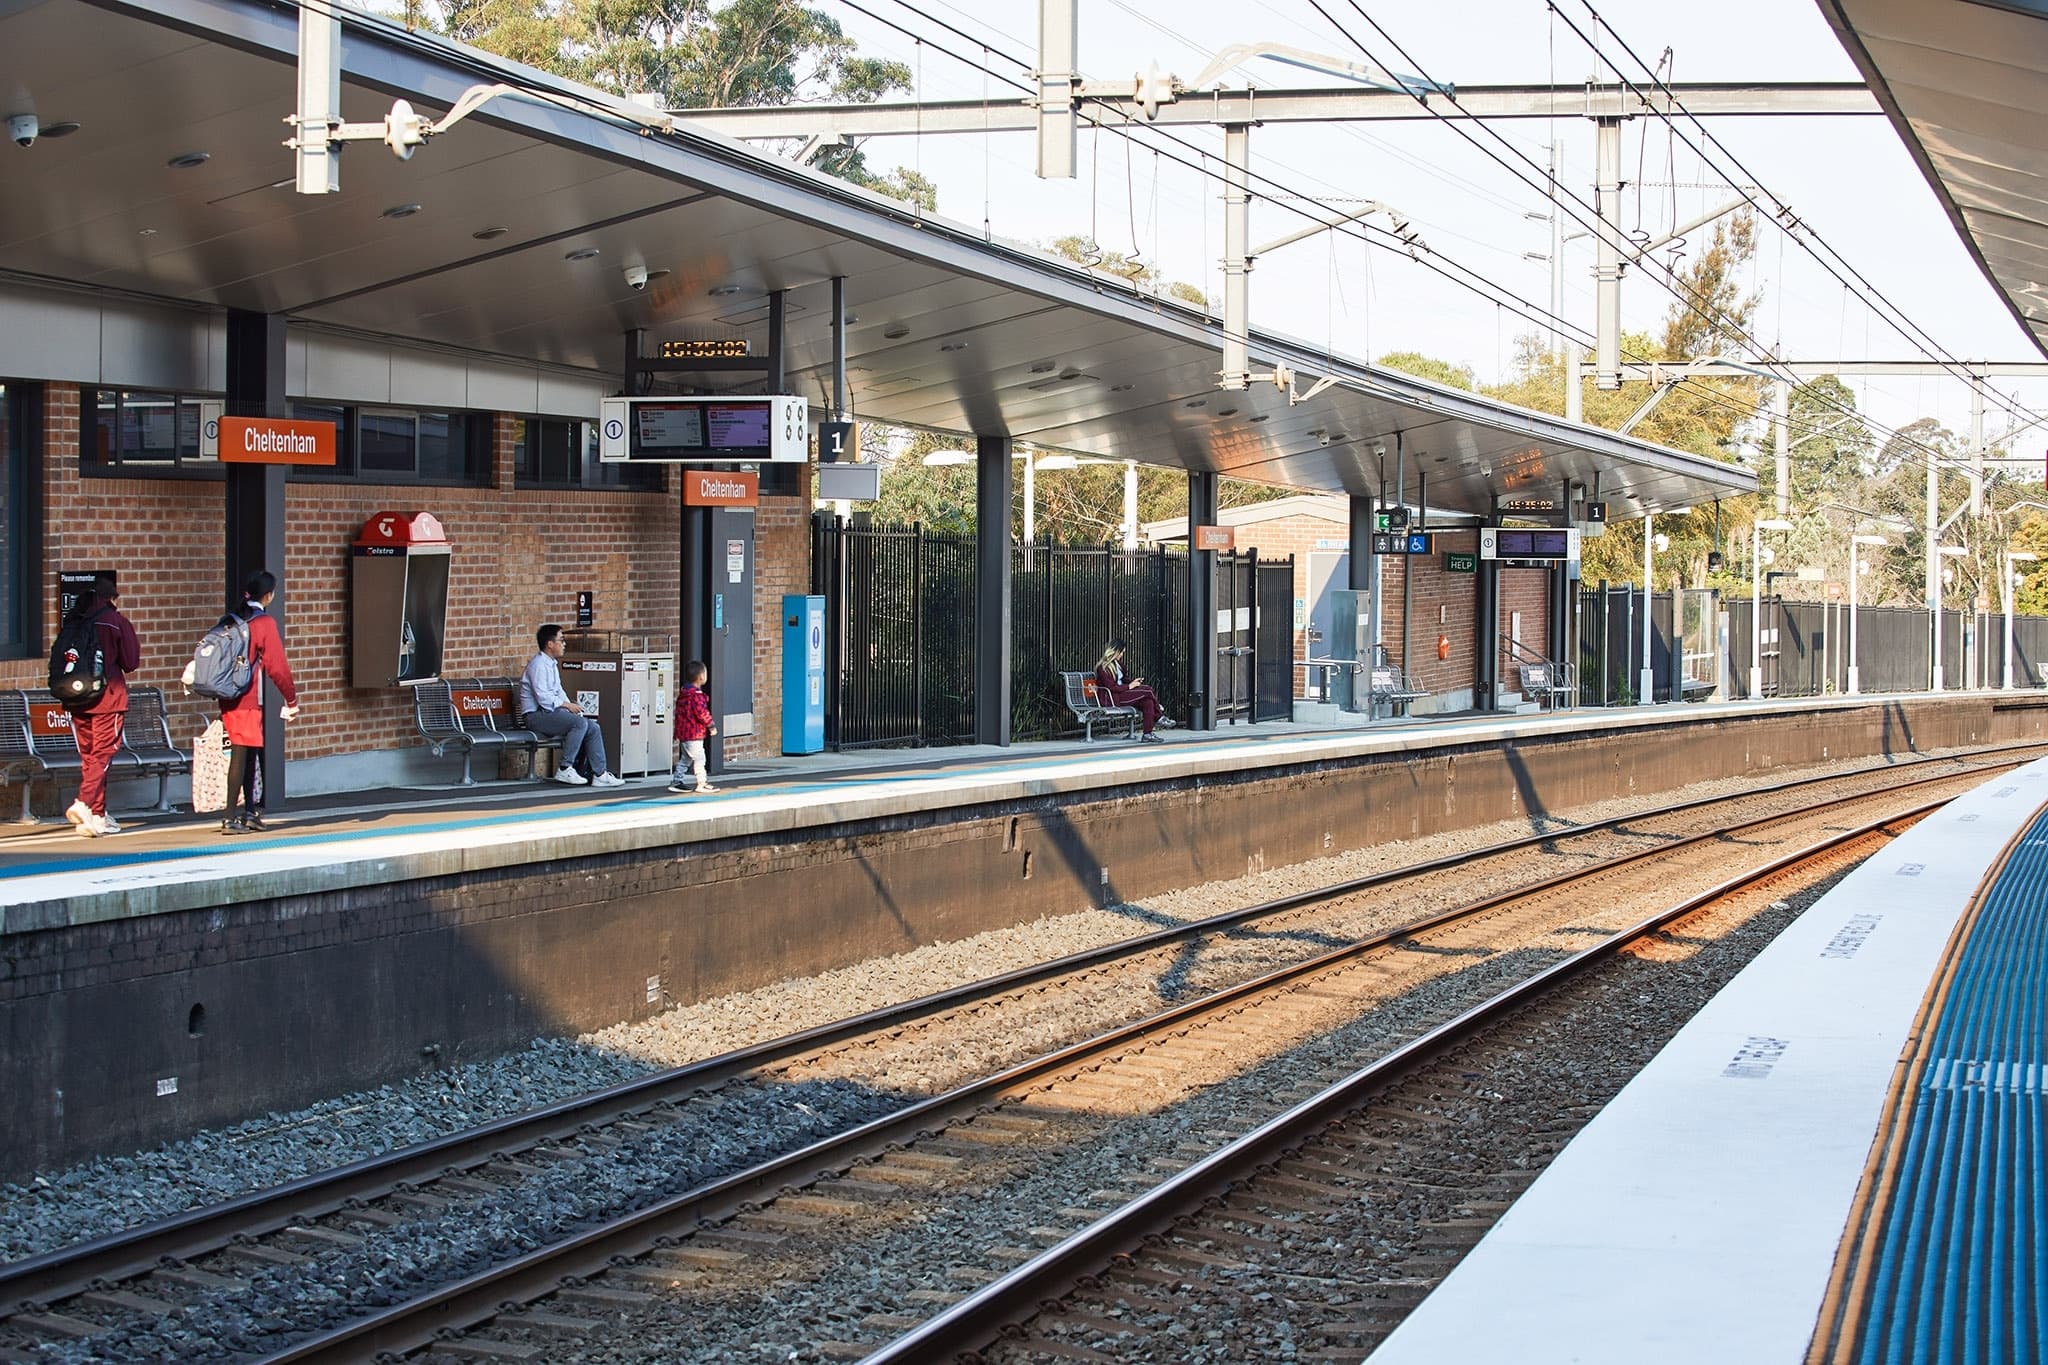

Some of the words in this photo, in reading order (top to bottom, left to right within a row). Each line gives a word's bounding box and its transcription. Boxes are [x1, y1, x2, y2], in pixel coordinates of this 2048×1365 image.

[245, 428, 316, 453] Cheltenham
[831, 431, 844, 453] 1
[701, 479, 746, 498] Cheltenham
[1593, 507, 1600, 518] 1
[368, 547, 394, 556] Telstra
[1450, 561, 1472, 569] HELP
